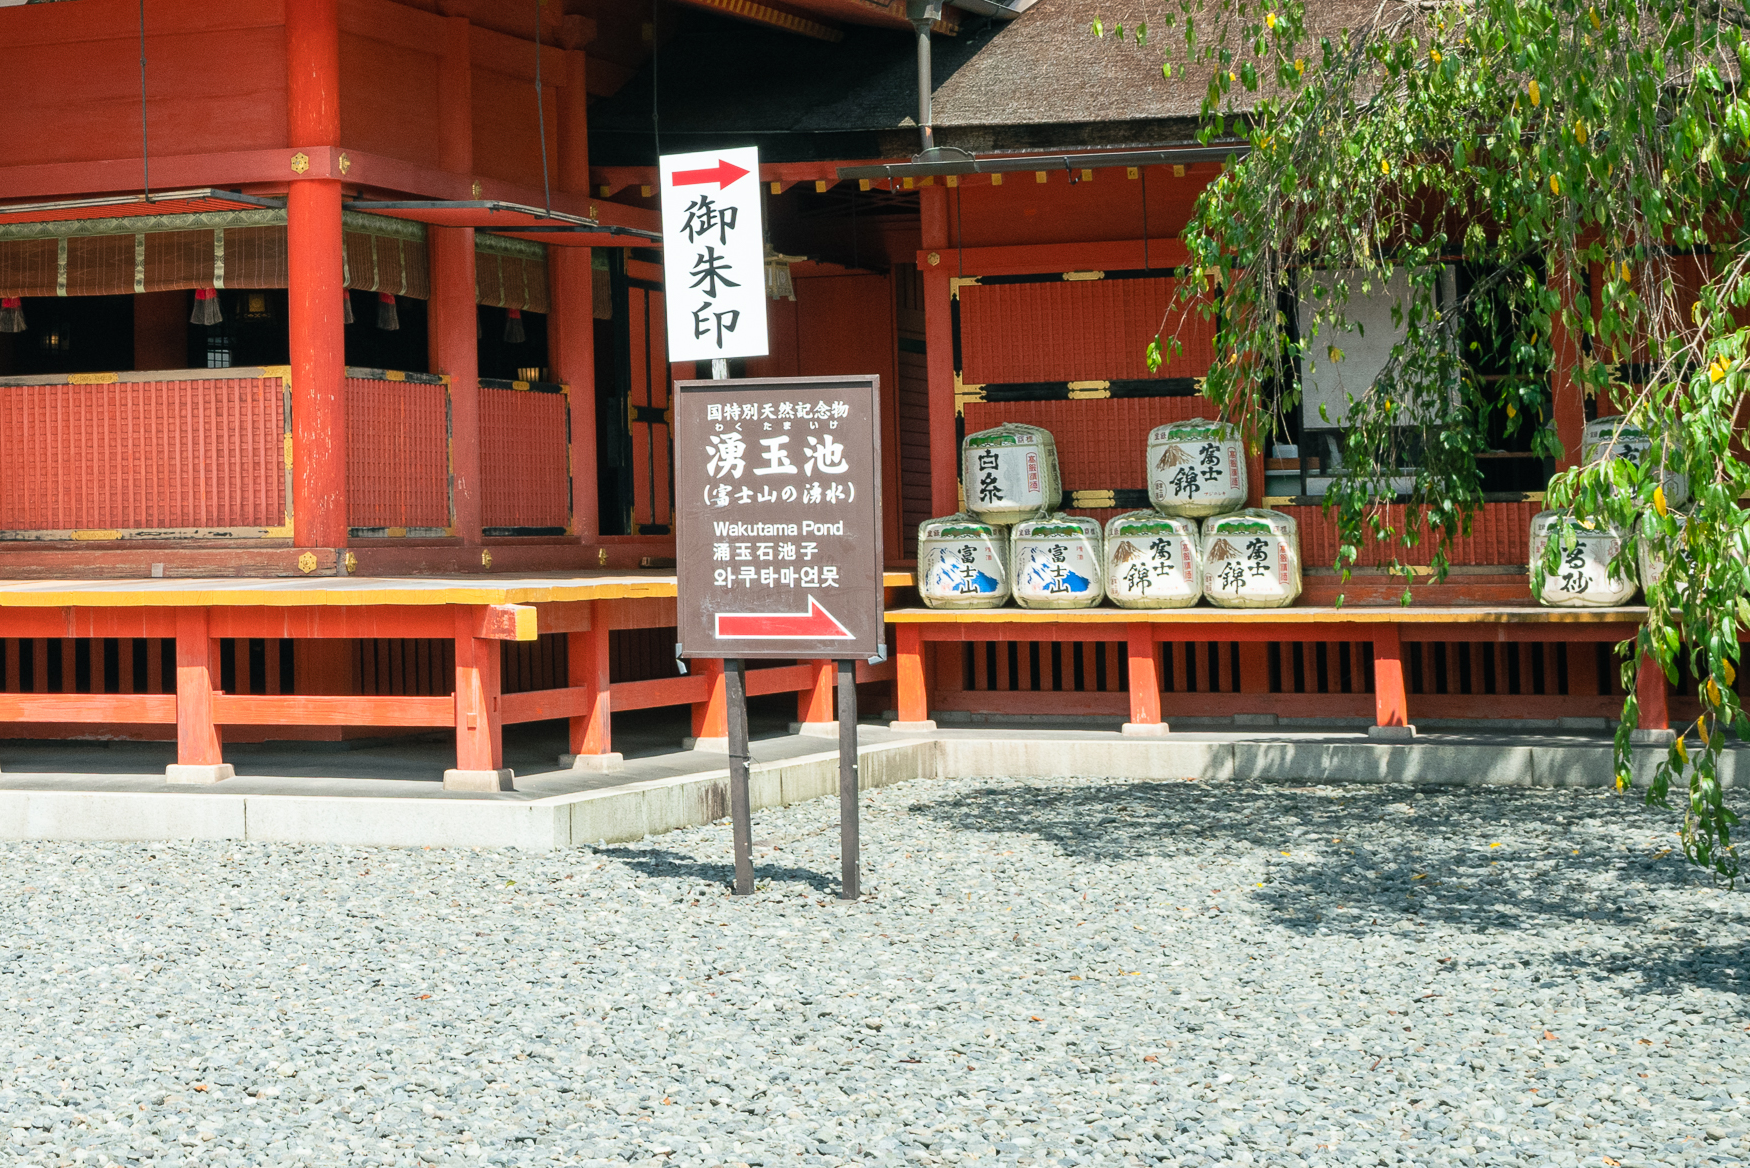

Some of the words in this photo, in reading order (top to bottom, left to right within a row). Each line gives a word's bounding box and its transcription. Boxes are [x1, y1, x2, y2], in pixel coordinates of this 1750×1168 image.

[680, 194, 742, 350] 御朱印
[706, 400, 849, 421] 国特別天然記念物
[714, 422, 743, 432] わく
[763, 421, 792, 431] たま
[809, 420, 839, 430] いけ
[705, 431, 850, 479] 湧玉池
[977, 448, 1004, 504] 白糸
[703, 482, 855, 508] (富士山の湧水)
[713, 521, 798, 537] Wakutama
[802, 520, 844, 536] Pond
[712, 541, 819, 561] 涌玉石池子
[713, 565, 840, 588] 와쿠타마연못
[957, 544, 979, 595] 富士山
[1047, 543, 1070, 595] 富士山
